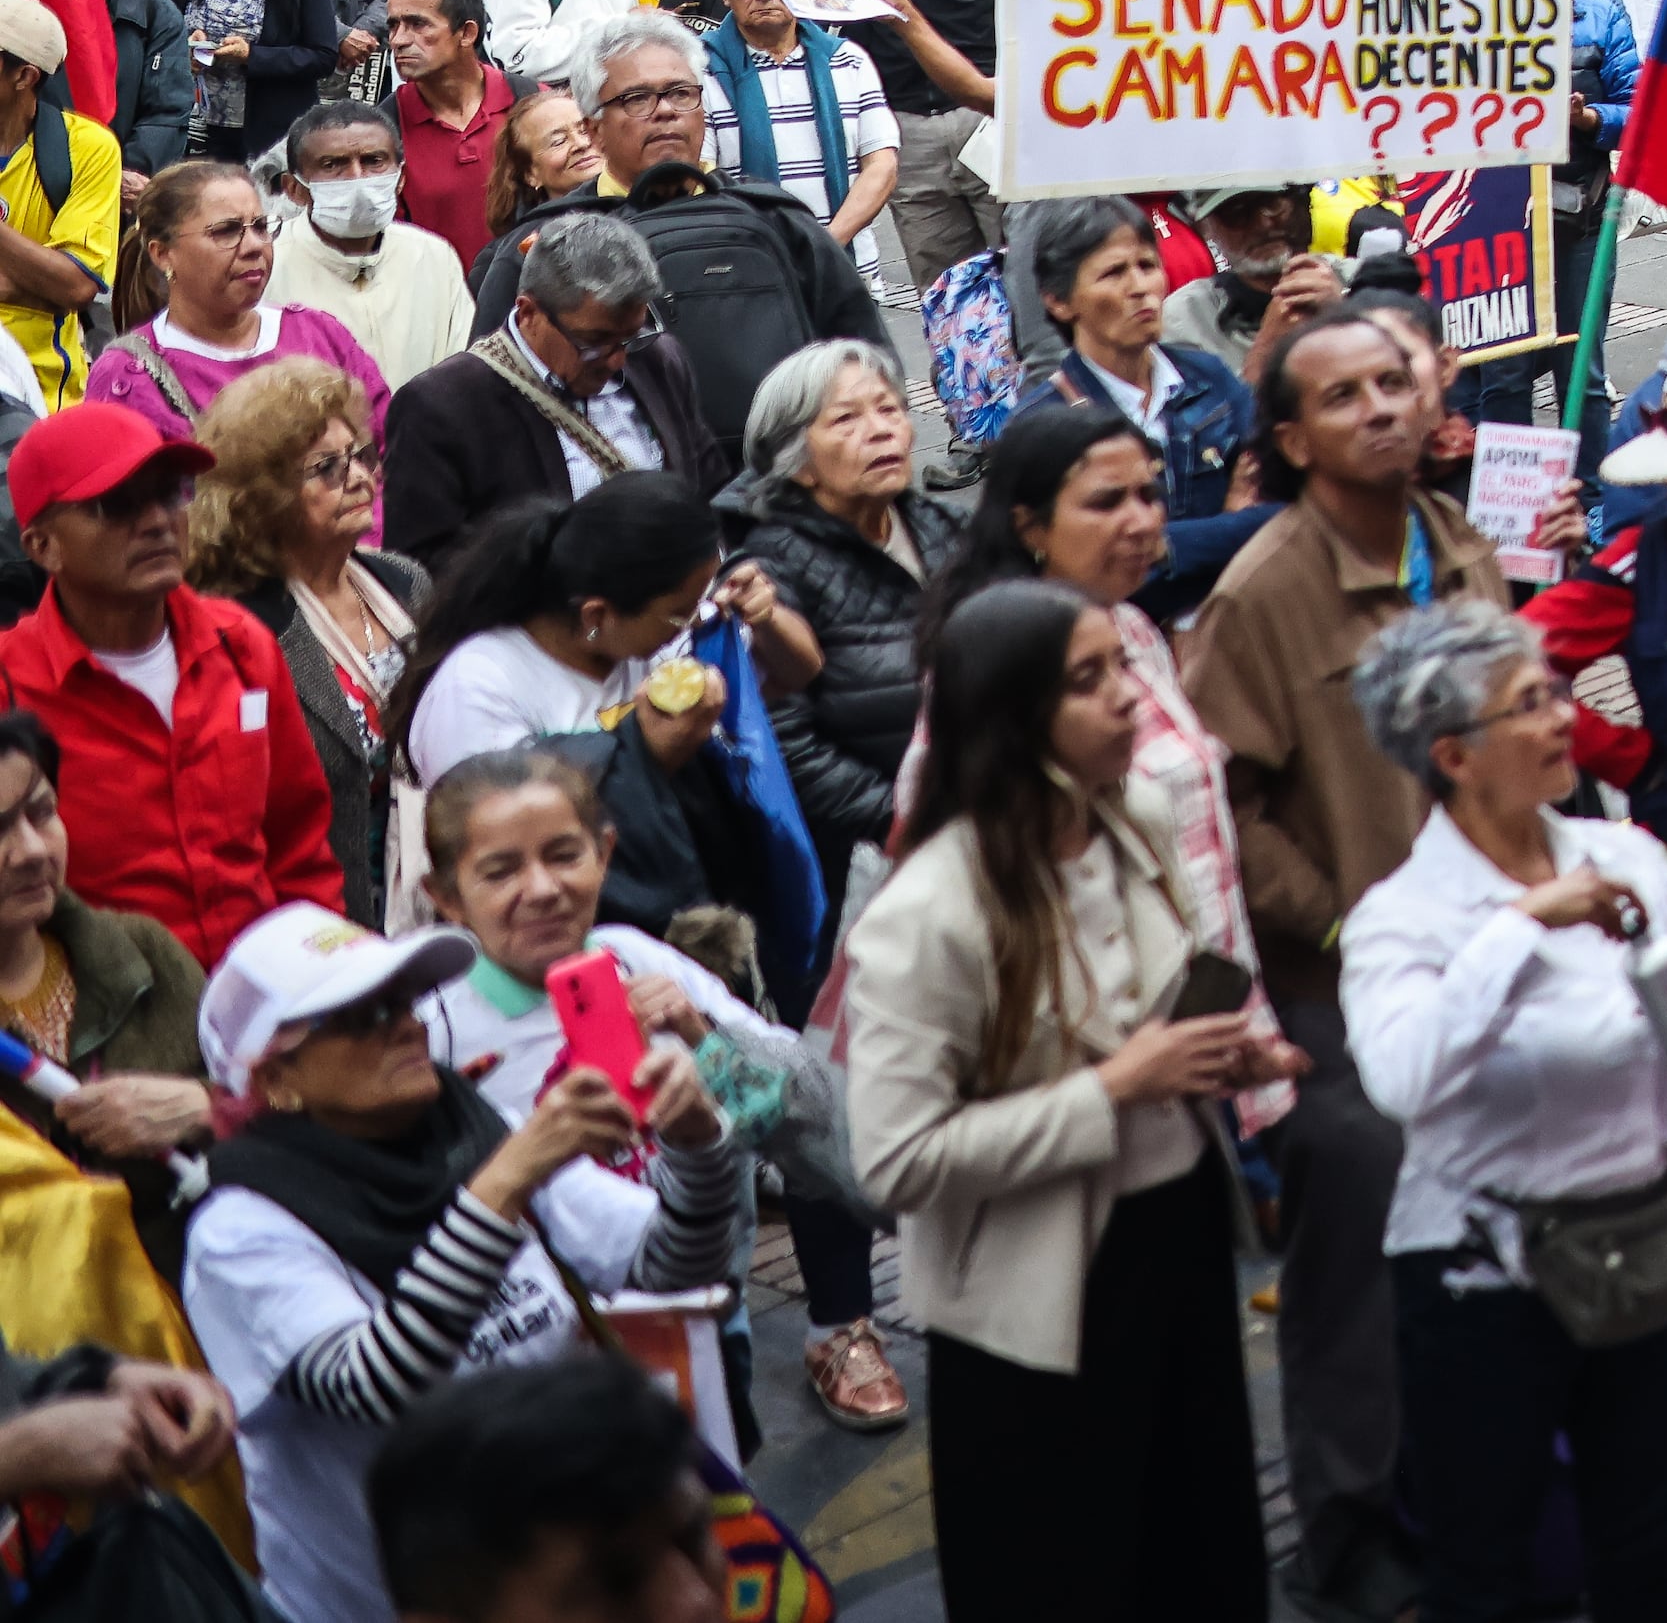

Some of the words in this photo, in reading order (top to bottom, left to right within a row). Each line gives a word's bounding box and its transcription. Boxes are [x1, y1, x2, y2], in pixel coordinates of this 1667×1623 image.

[1042, 37, 1360, 129] CÁMARA
[1355, 37, 1558, 93] DECENTES
[1441, 273, 1530, 350] GUZMÁN
